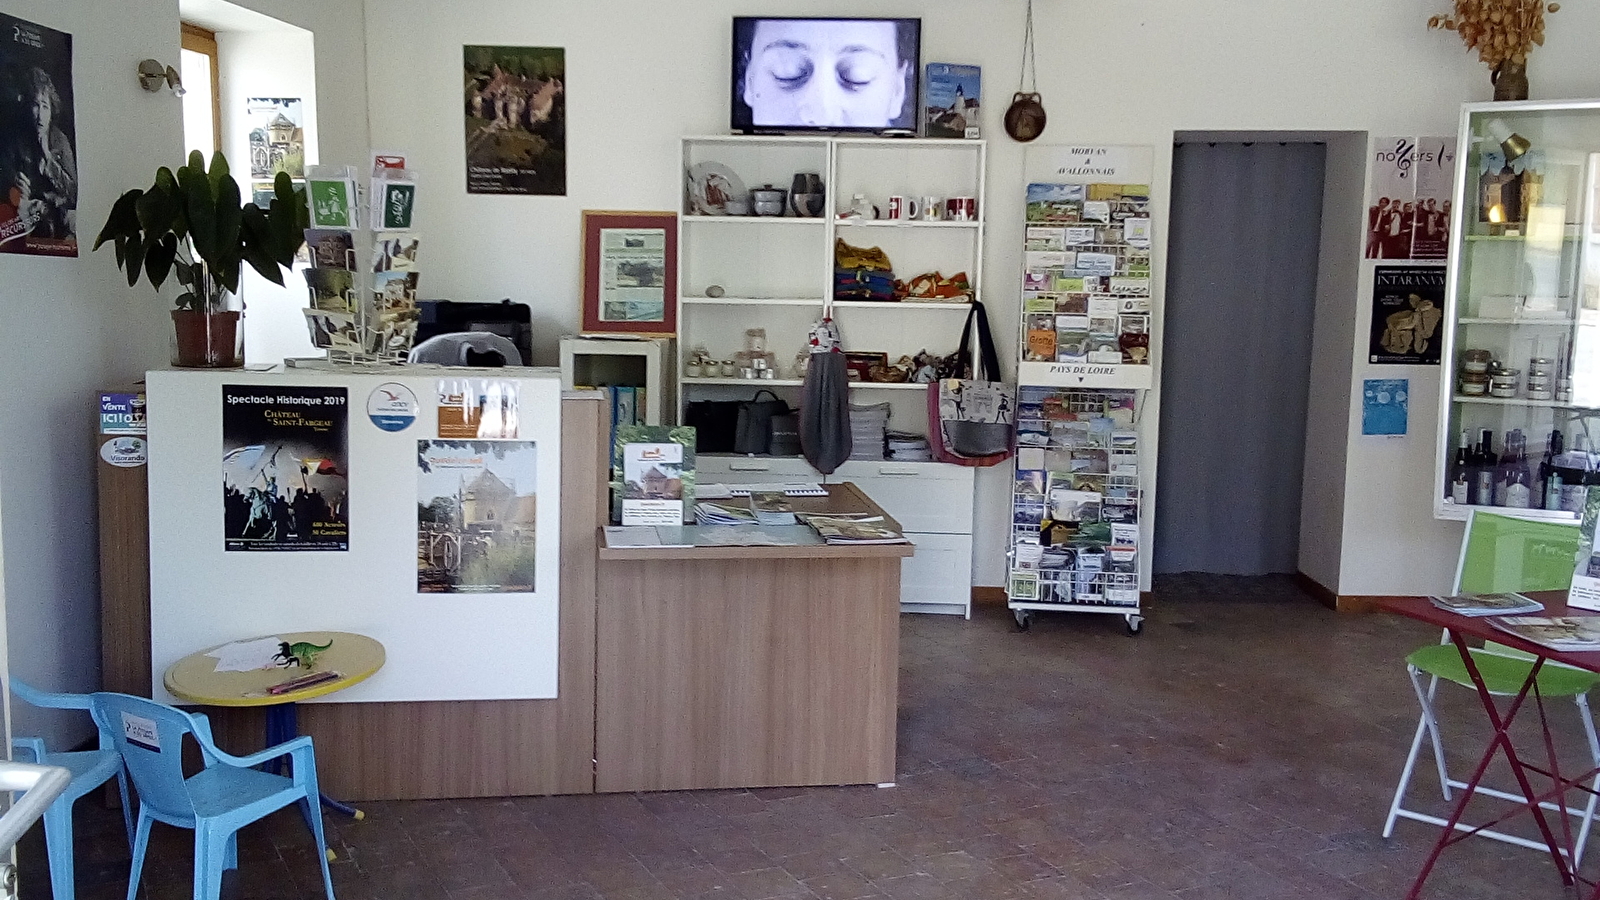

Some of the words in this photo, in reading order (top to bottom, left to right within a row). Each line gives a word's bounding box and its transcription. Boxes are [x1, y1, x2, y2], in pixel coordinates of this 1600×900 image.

[1071, 147, 1107, 155] MORVAN
[1049, 366, 1071, 374] PAYS
[1073, 366, 1086, 374] DE
[1087, 366, 1116, 375] LOIRE
[227, 394, 275, 405] Spectacle
[276, 395, 322, 406] Historique
[323, 396, 346, 405] 2019
[102, 402, 126, 411] VENTE
